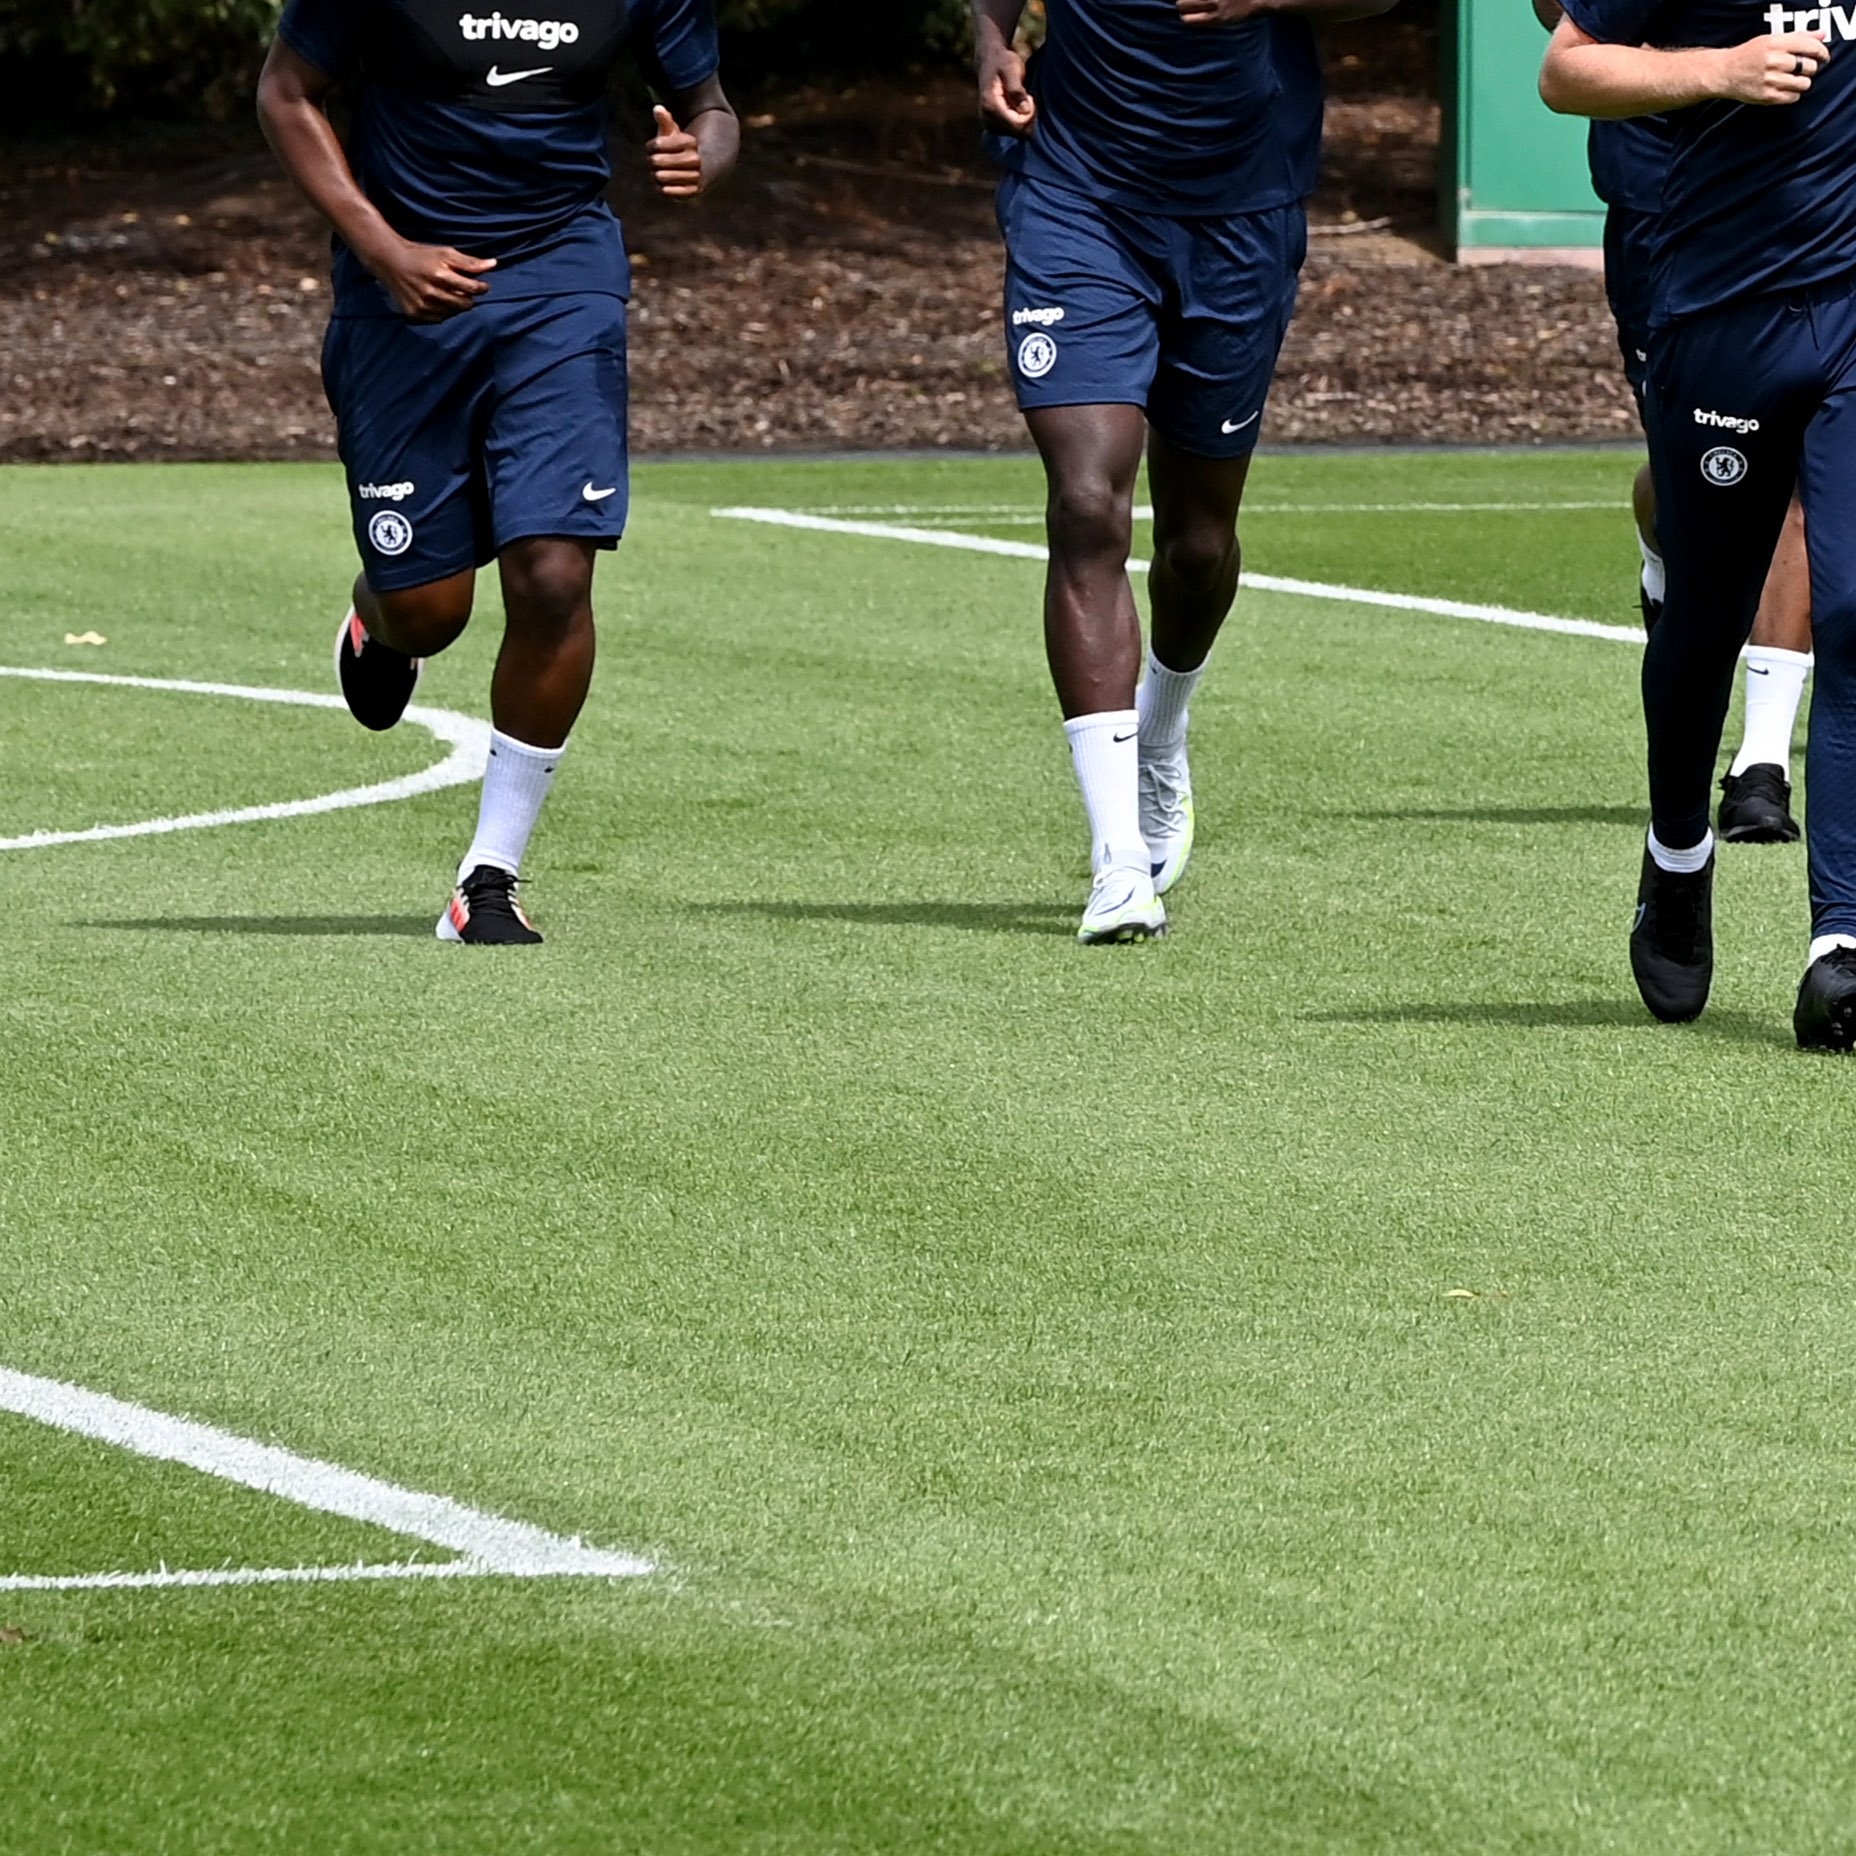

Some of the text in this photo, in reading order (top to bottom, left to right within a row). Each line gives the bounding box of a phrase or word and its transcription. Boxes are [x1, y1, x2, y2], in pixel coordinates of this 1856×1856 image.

[458, 11, 579, 50] trivago
[1012, 307, 1065, 326] trivago
[1693, 408, 1760, 434] trivago
[358, 481, 415, 502] trivago
